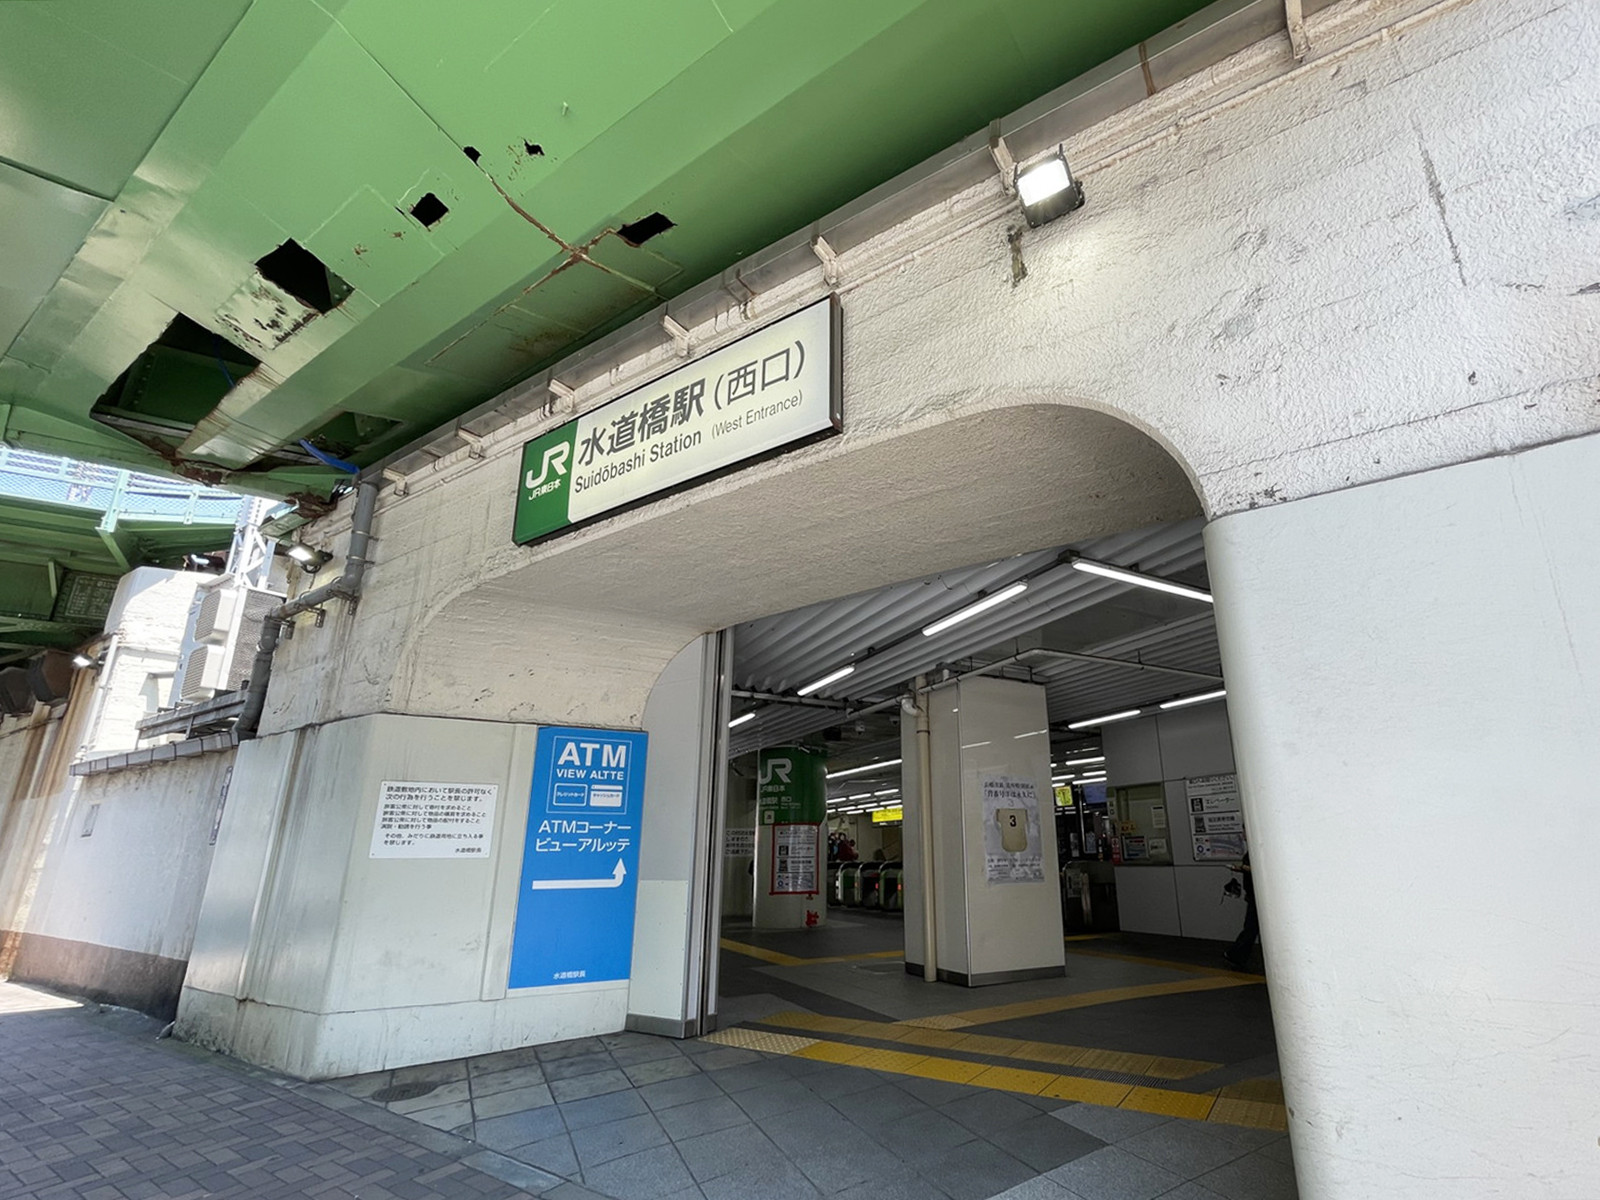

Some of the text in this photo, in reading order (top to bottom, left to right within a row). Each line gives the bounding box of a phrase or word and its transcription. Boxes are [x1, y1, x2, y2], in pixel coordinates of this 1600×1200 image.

[575, 389, 803, 493] Suidōbashi Station (West Entrance)
[525, 441, 570, 489] JR
[528, 479, 562, 500] JR東日本
[557, 742, 627, 768] ATM
[556, 769, 624, 781] VIEW ALTTE
[758, 757, 793, 785] JR
[538, 820, 632, 835] ATMコーナー
[1009, 815, 1017, 827] 3
[536, 838, 631, 852] ビューアルッテ
